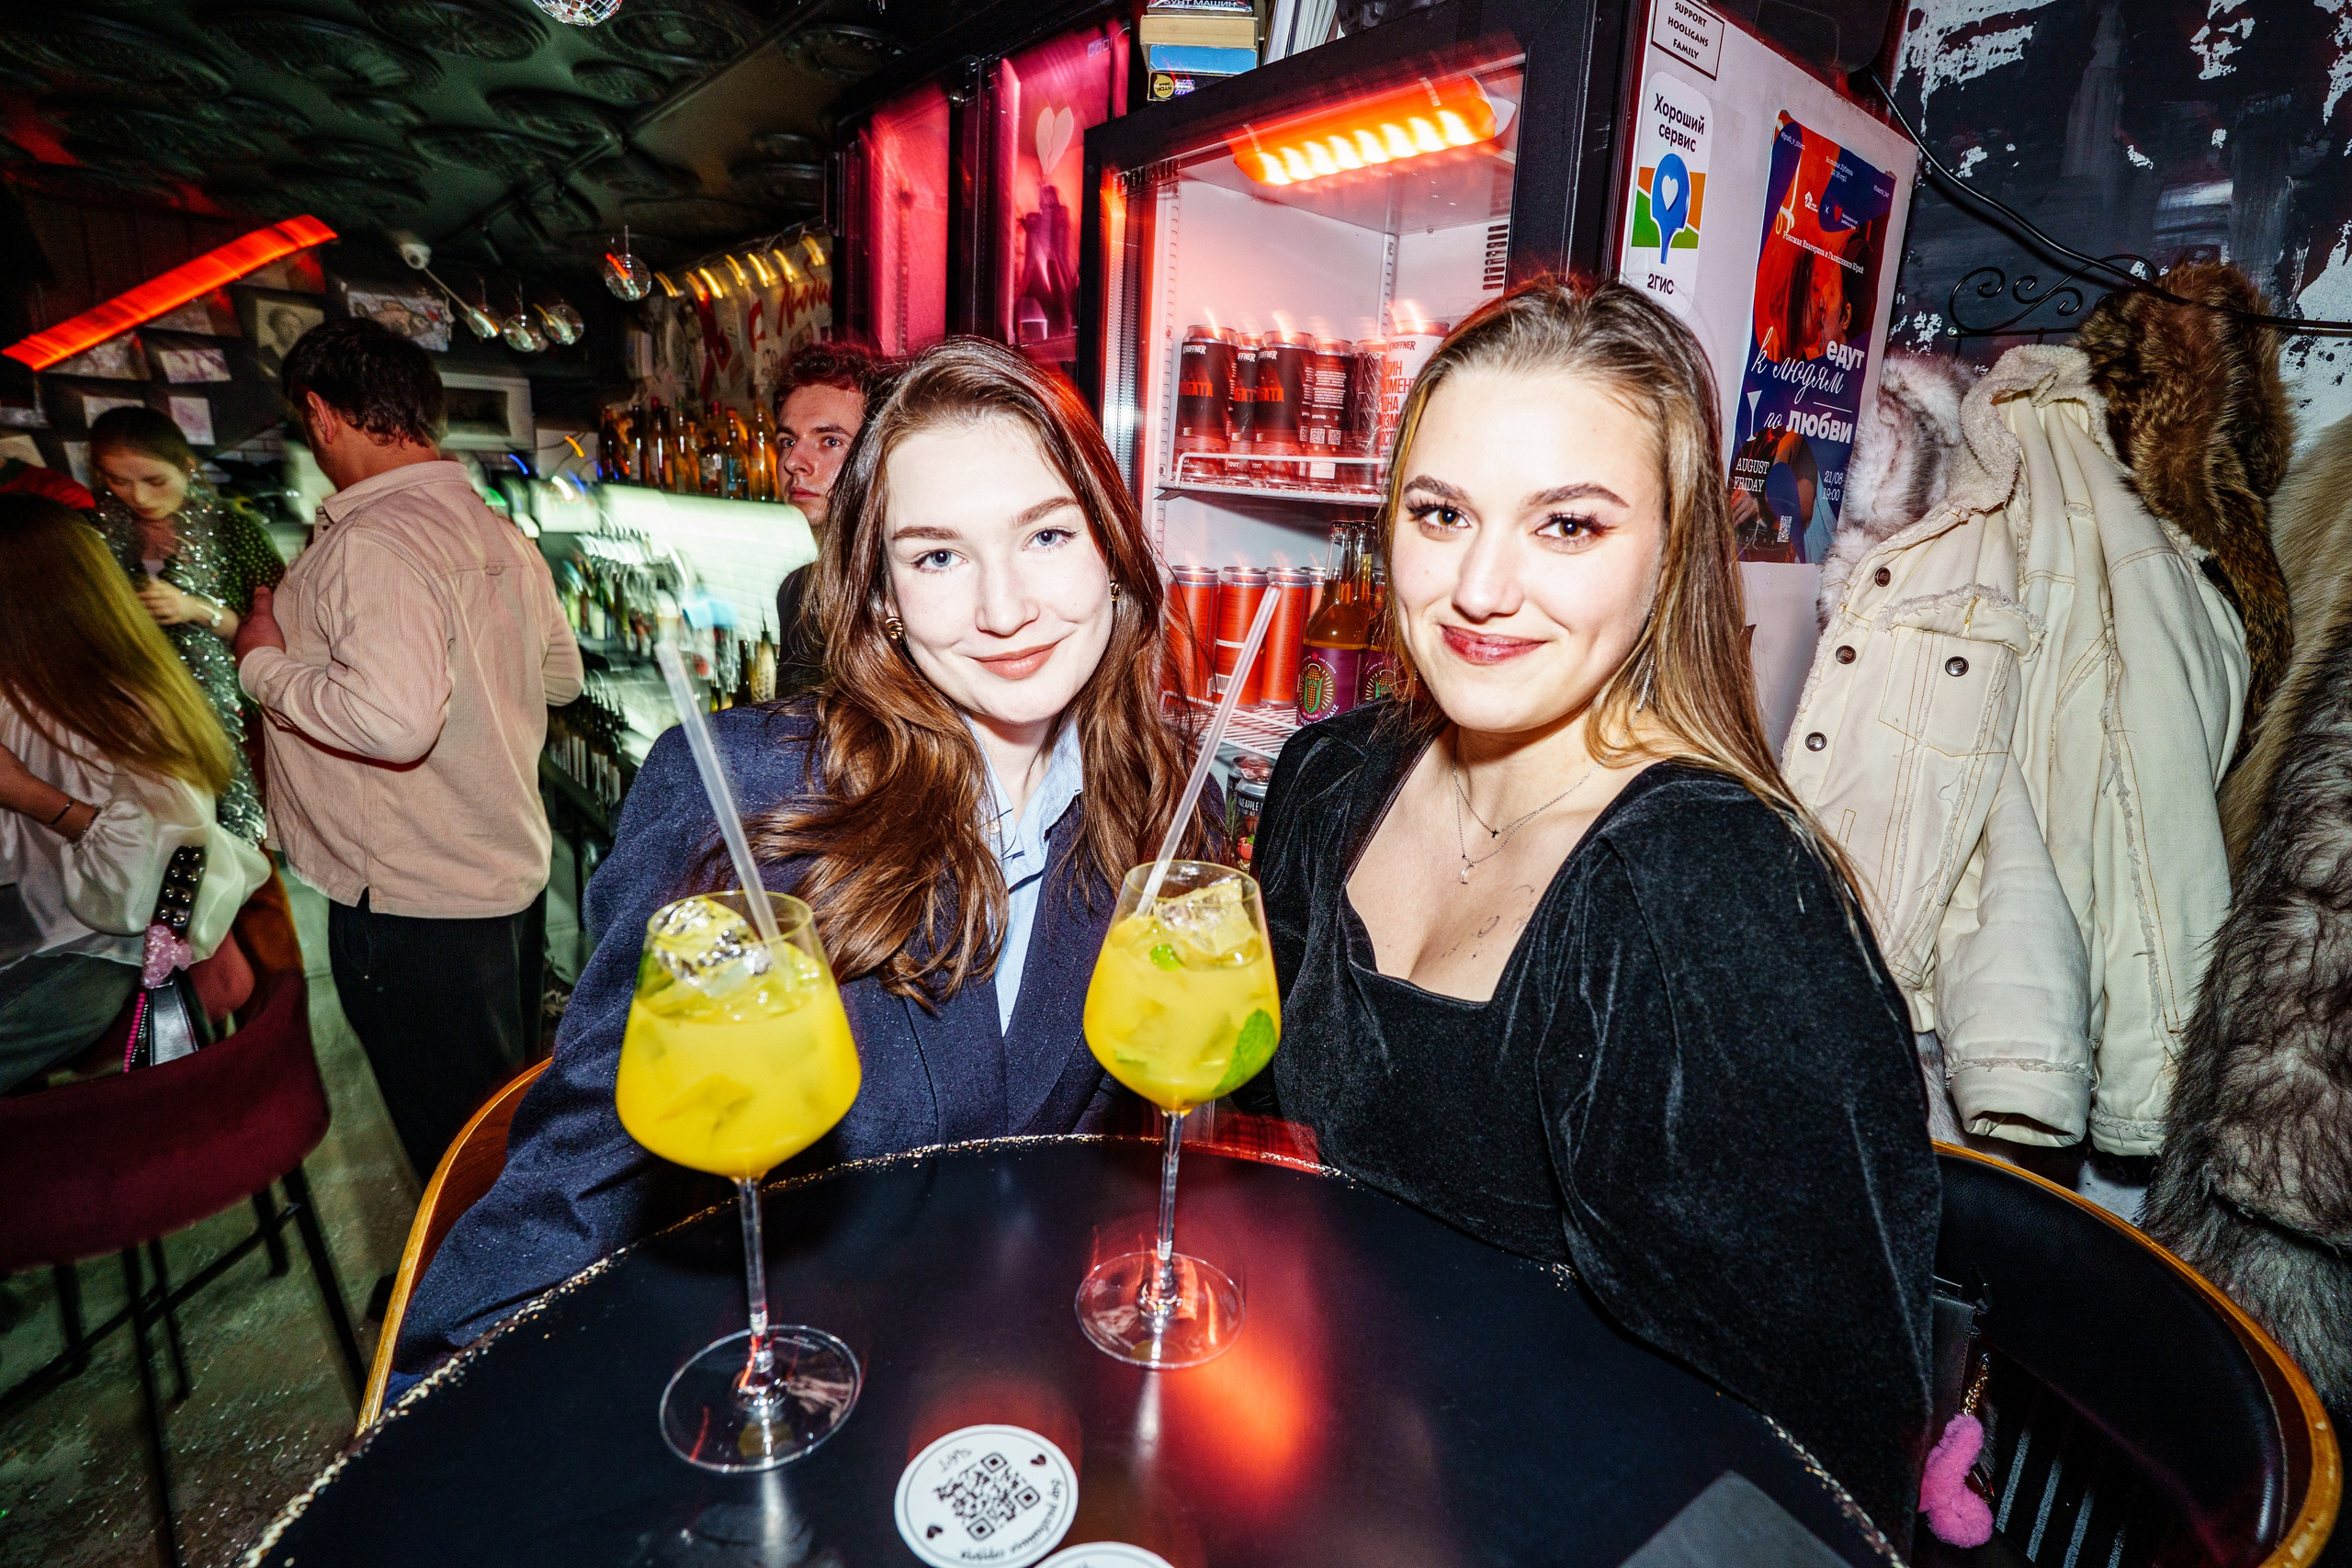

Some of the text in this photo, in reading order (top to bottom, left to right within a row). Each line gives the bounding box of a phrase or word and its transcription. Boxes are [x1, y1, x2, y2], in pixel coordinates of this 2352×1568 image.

[1675, 2, 1708, 28] SUPPORT
[1668, 16, 1709, 47] HOOLIGANS
[1673, 38, 1700, 60] FAMILY
[1654, 92, 1705, 135] Хороший
[1658, 123, 1697, 152] сервис
[1646, 273, 1674, 295] 2ГИС
[1237, 352, 1256, 363] FFNER
[1826, 340, 1865, 371] едут
[1385, 360, 1403, 378] ДИН
[1772, 356, 1845, 405] людям
[1382, 395, 1399, 412] ДНА
[1763, 410, 1853, 444] по любви
[1736, 457, 1770, 475] AUGUST
[1823, 469, 1844, 485] 21/08
[1733, 476, 1765, 492] FRIDAY
[1822, 487, 1841, 502] 19:00
[1292, 595, 1301, 633] ЗДОРОВЬЮ
[1288, 635, 1297, 665] ВАШЕМУ
